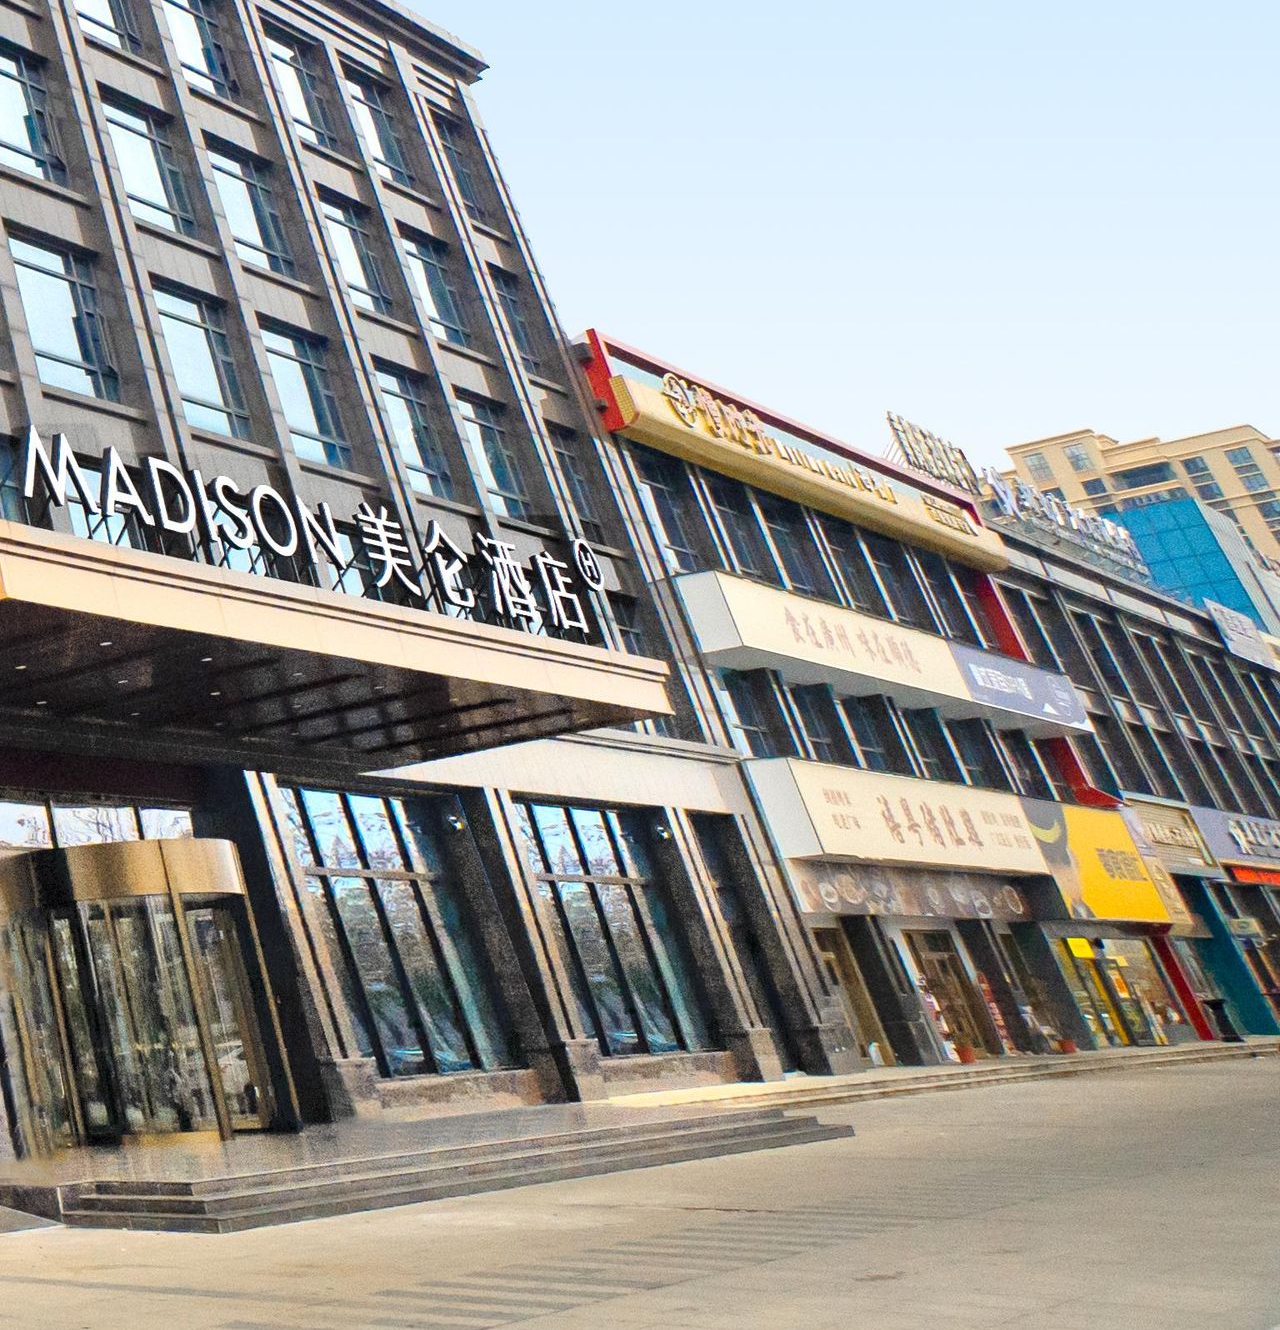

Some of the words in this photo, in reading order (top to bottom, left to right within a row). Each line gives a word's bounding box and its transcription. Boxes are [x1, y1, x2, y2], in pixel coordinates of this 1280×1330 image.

[24, 424, 347, 569] MADISON
[353, 502, 590, 634] 美仑酒店
